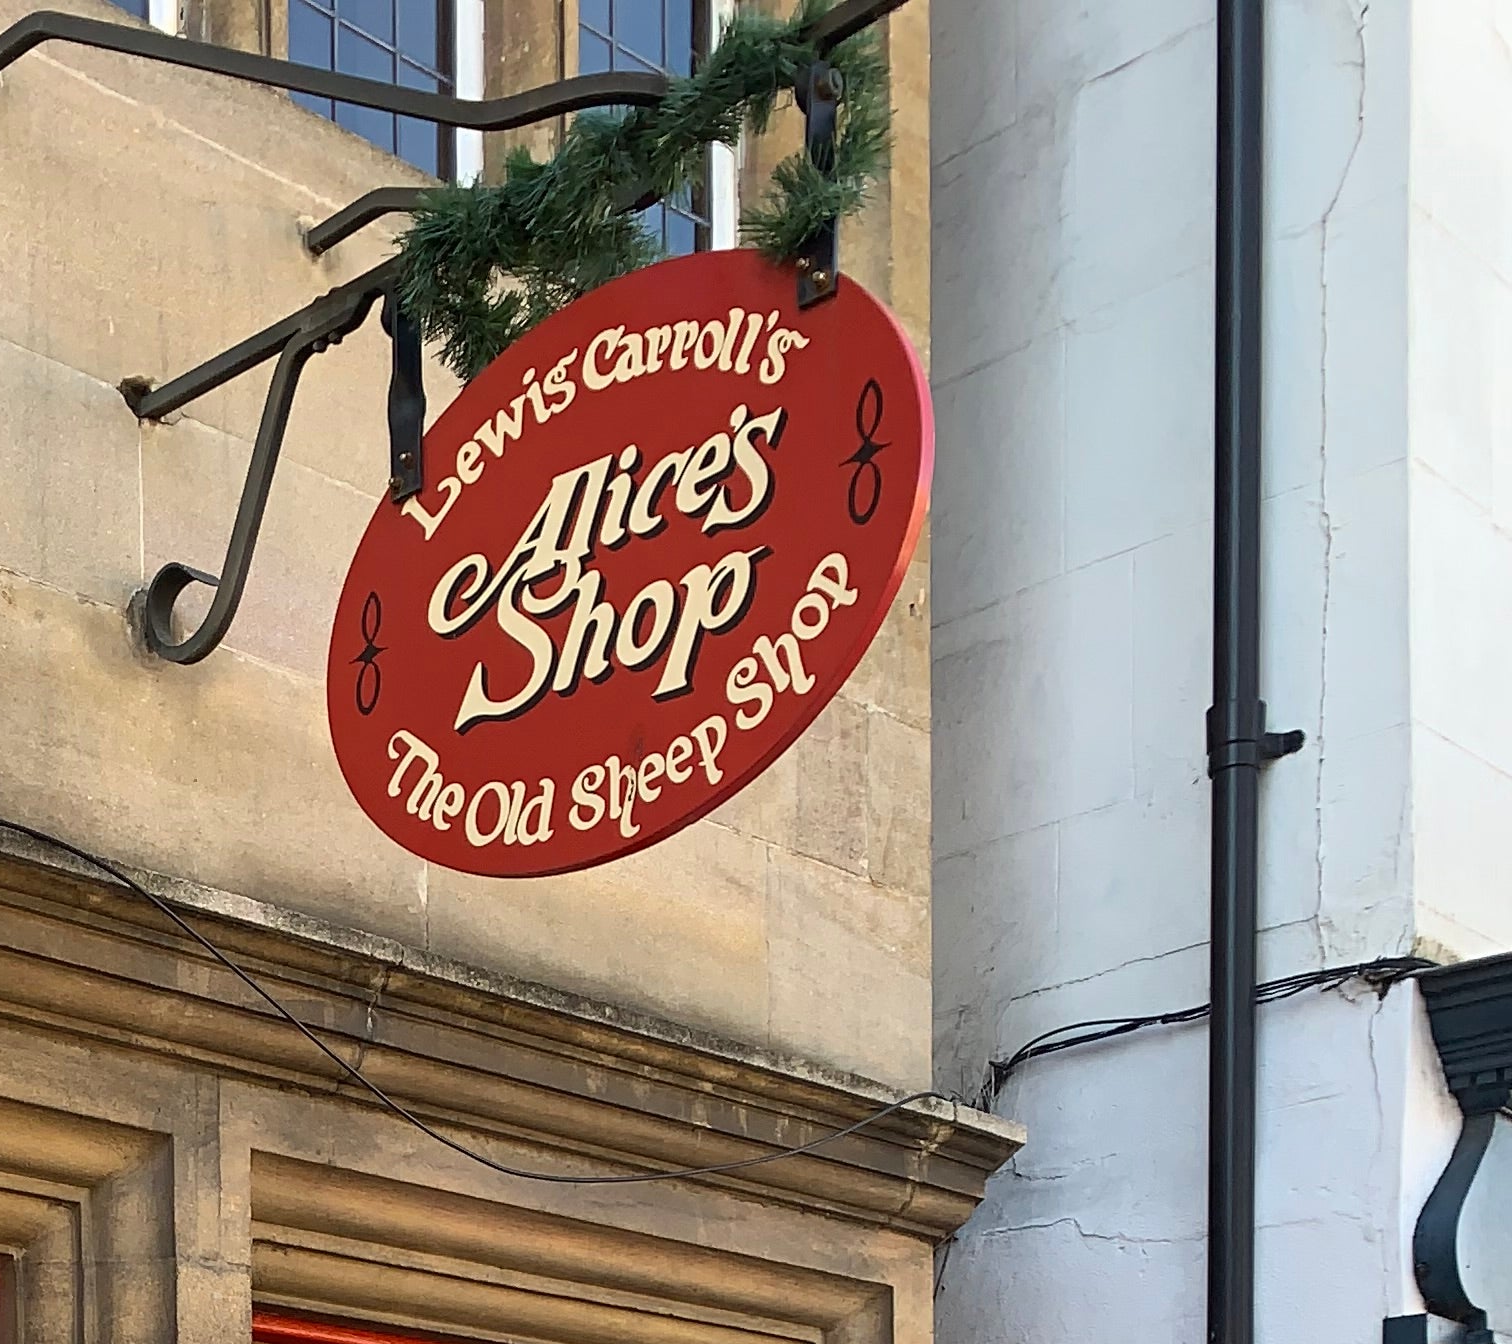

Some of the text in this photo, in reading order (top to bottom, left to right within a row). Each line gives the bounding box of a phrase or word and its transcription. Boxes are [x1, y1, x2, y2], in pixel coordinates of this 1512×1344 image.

[402, 307, 810, 540] Lewis Carroll's
[427, 404, 785, 638] Alice's
[387, 552, 859, 846] The Old Sheep Shop
[454, 546, 772, 732] Shop
